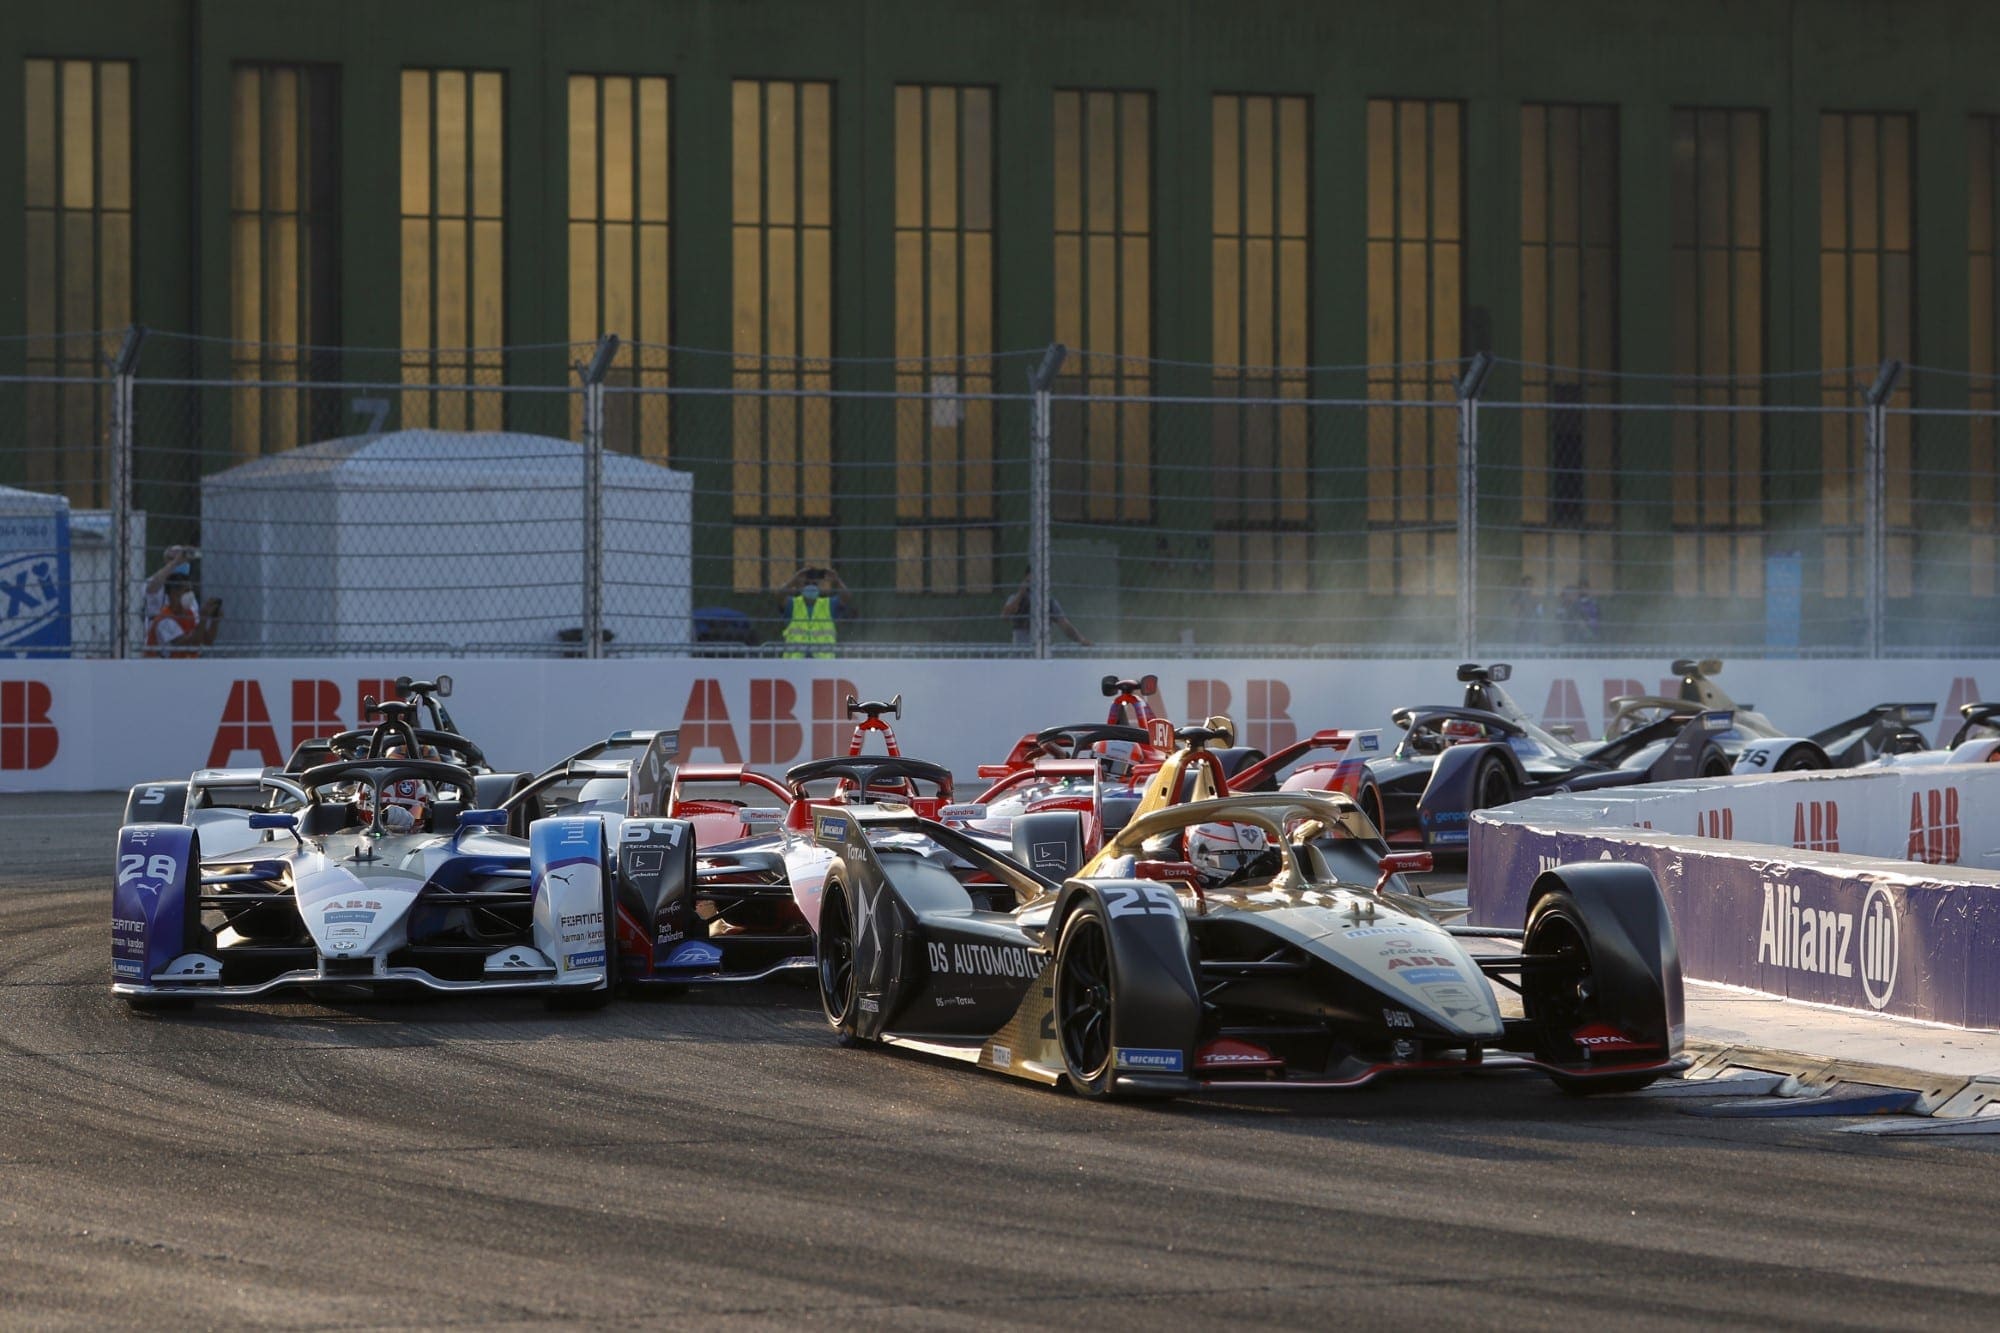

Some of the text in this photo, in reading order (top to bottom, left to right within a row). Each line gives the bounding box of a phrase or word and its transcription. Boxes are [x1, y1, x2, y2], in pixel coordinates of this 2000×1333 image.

[1153, 723, 1169, 747] JEV
[138, 787, 166, 804] 5
[623, 822, 683, 848] 64
[1907, 787, 1961, 864] ABB
[847, 843, 867, 860] TOTAL
[119, 854, 177, 885] 28
[1163, 868, 1192, 876] TOTAL
[1103, 887, 1180, 919] 25
[1758, 882, 1853, 978] Allianz
[928, 942, 1052, 979] DS AUTOMOBIL
[1388, 956, 1456, 970] ABB
[1575, 1036, 1632, 1044] TOTAL
[1129, 1055, 1177, 1065] MICHELIN
[1203, 1053, 1268, 1062] TOTAL
